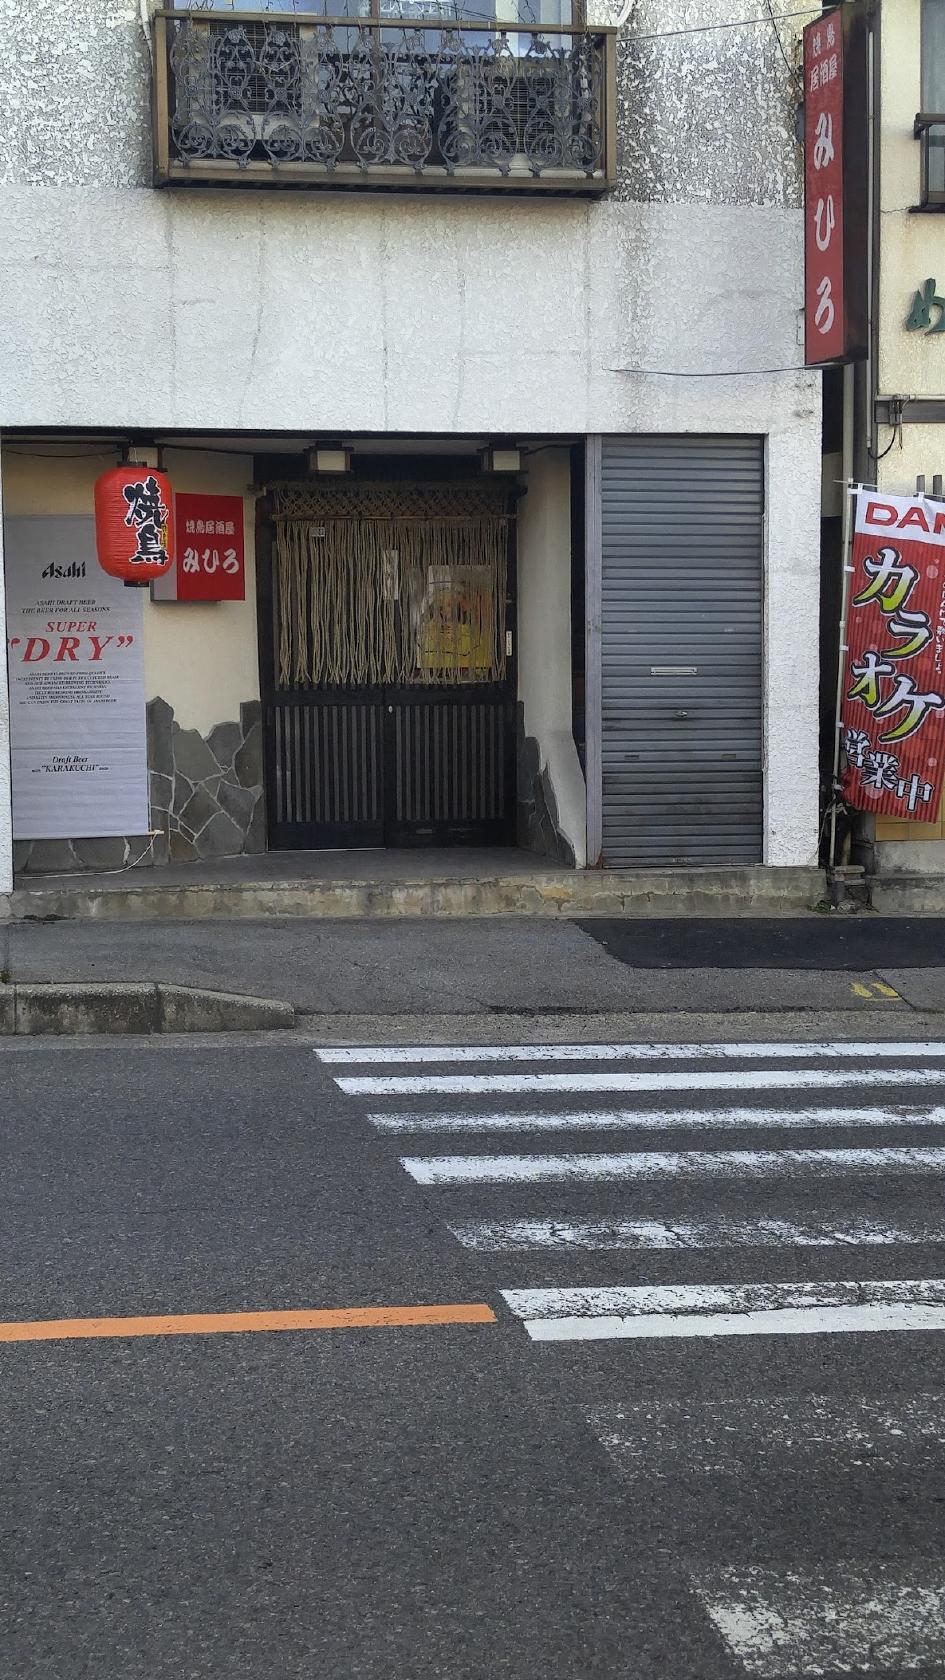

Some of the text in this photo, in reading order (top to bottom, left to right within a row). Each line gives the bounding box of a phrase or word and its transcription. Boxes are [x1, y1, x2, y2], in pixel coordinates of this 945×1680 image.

[811, 53, 838, 92] 居酒屋
[813, 112, 835, 335] みひろ
[123, 476, 169, 567] 焼鳥
[185, 519, 235, 536] 焼鳥居酒屋
[865, 501, 945, 535] DA
[41, 560, 87, 580] Asahi
[183, 547, 240, 574] みひろ
[45, 621, 98, 633] SUPER
[848, 546, 945, 744] カラオケ
[52, 755, 89, 764] Draft Beer
[845, 728, 934, 812] 営業中
